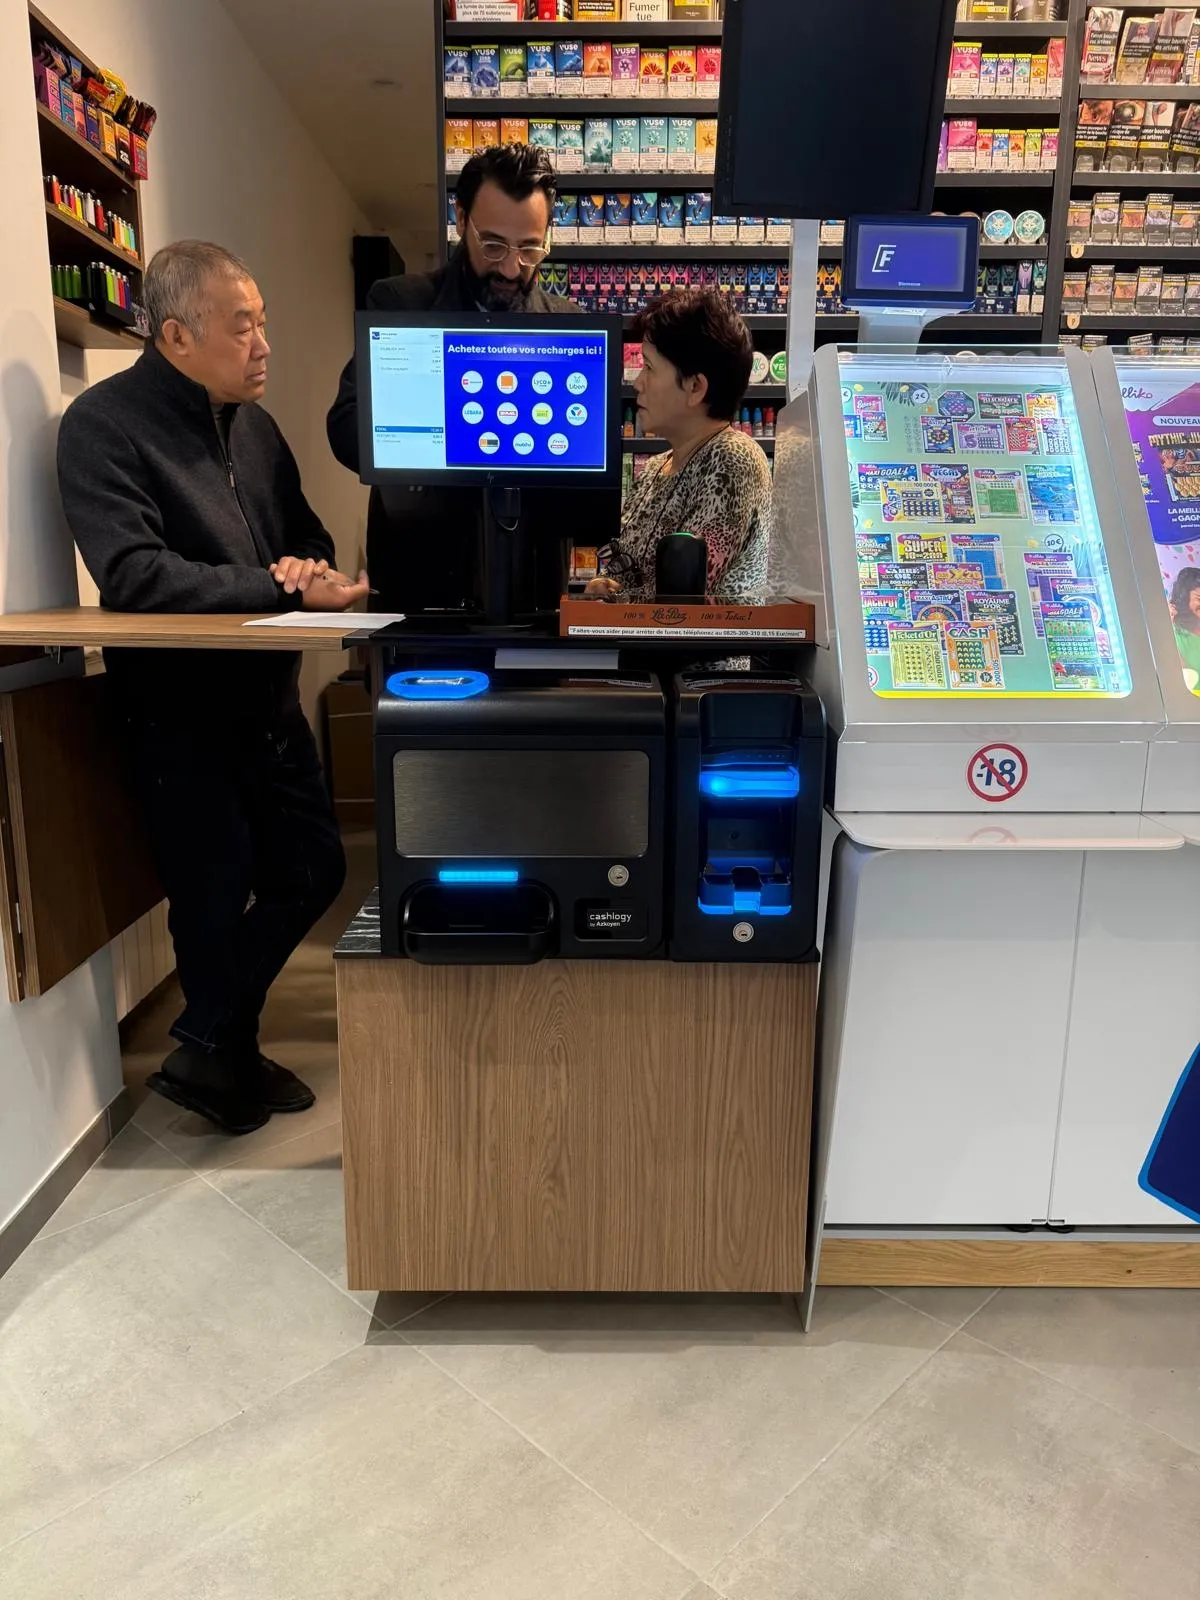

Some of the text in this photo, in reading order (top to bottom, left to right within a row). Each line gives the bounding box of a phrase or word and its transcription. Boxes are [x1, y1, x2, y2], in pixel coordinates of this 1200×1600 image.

[630, 2, 660, 11] Fumer
[637, 12, 652, 20] tue
[1087, 54, 1106, 62] News
[448, 344, 486, 354] Achetez
[488, 345, 517, 354] toutes
[537, 345, 584, 356] recharges
[586, 346, 597, 355] ici
[1148, 432, 1186, 446] MYTHIC
[904, 540, 943, 552] SUPER
[724, 610, 746, 621] Tabac
[949, 629, 989, 638] CASH
[976, 758, 1016, 786] -18
[589, 912, 632, 922] cashlogy
